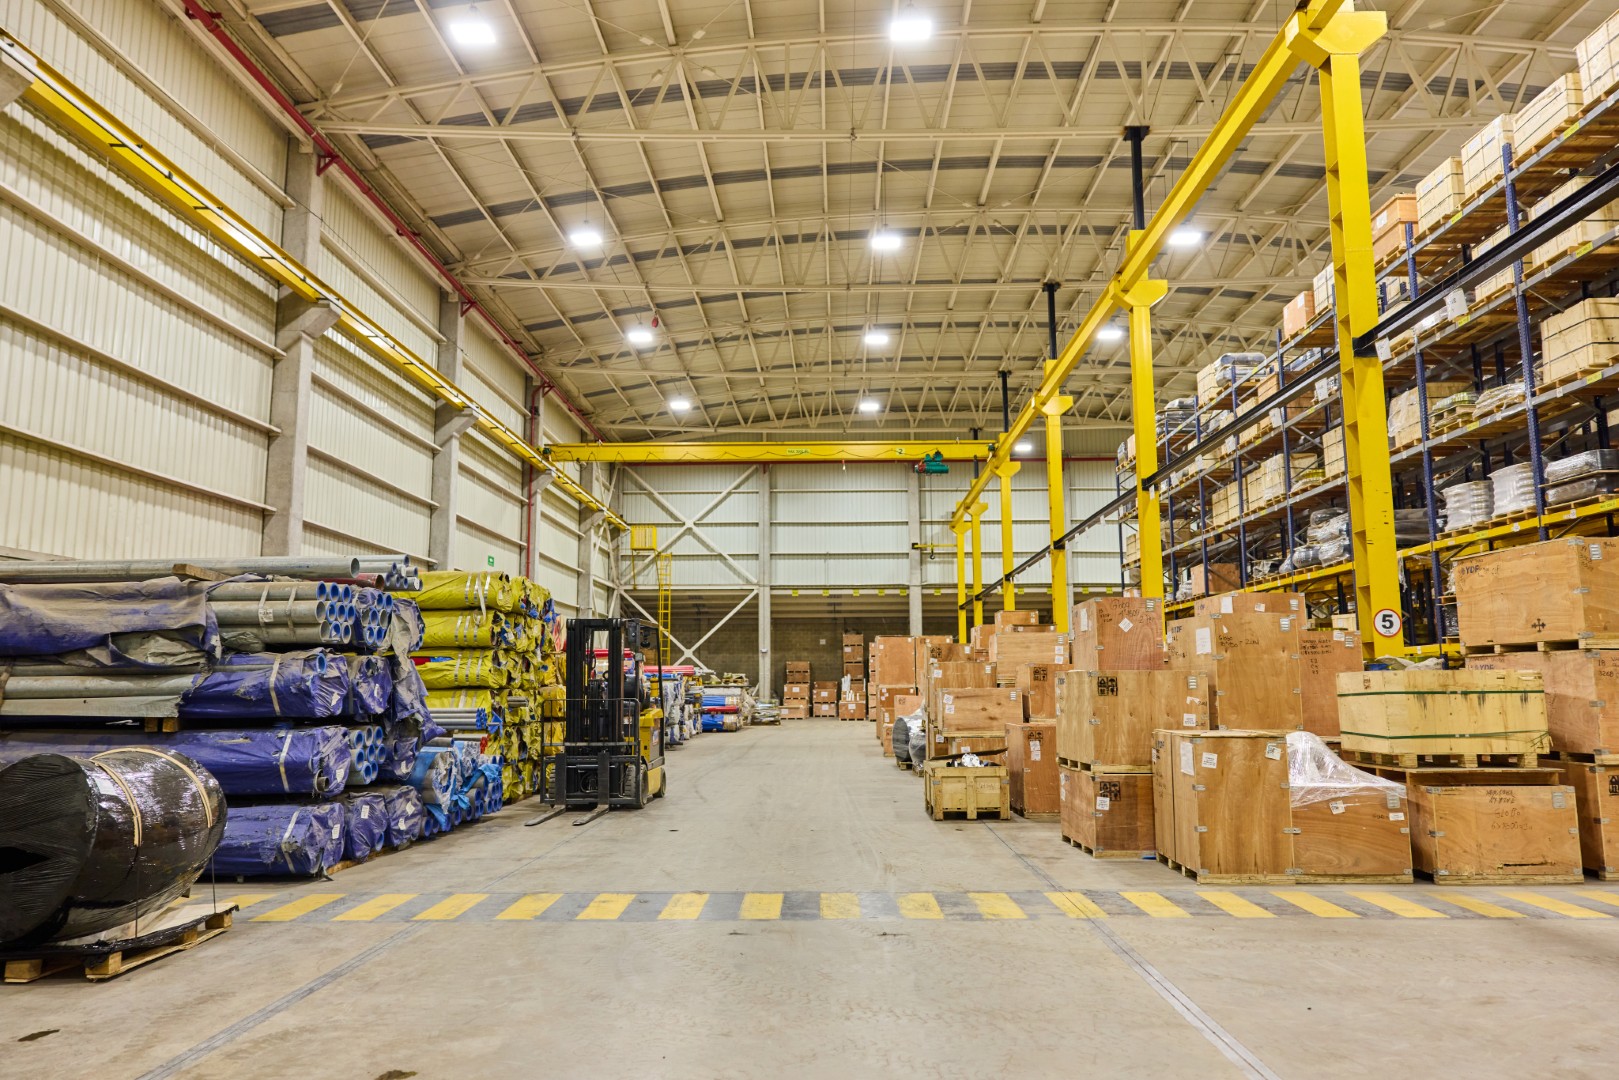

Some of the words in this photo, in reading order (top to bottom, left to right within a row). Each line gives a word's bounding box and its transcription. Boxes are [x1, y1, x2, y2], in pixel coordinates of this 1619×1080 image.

[897, 448, 904, 456] 2
[1381, 613, 1394, 630] 5
[1598, 659, 1606, 667] 18
